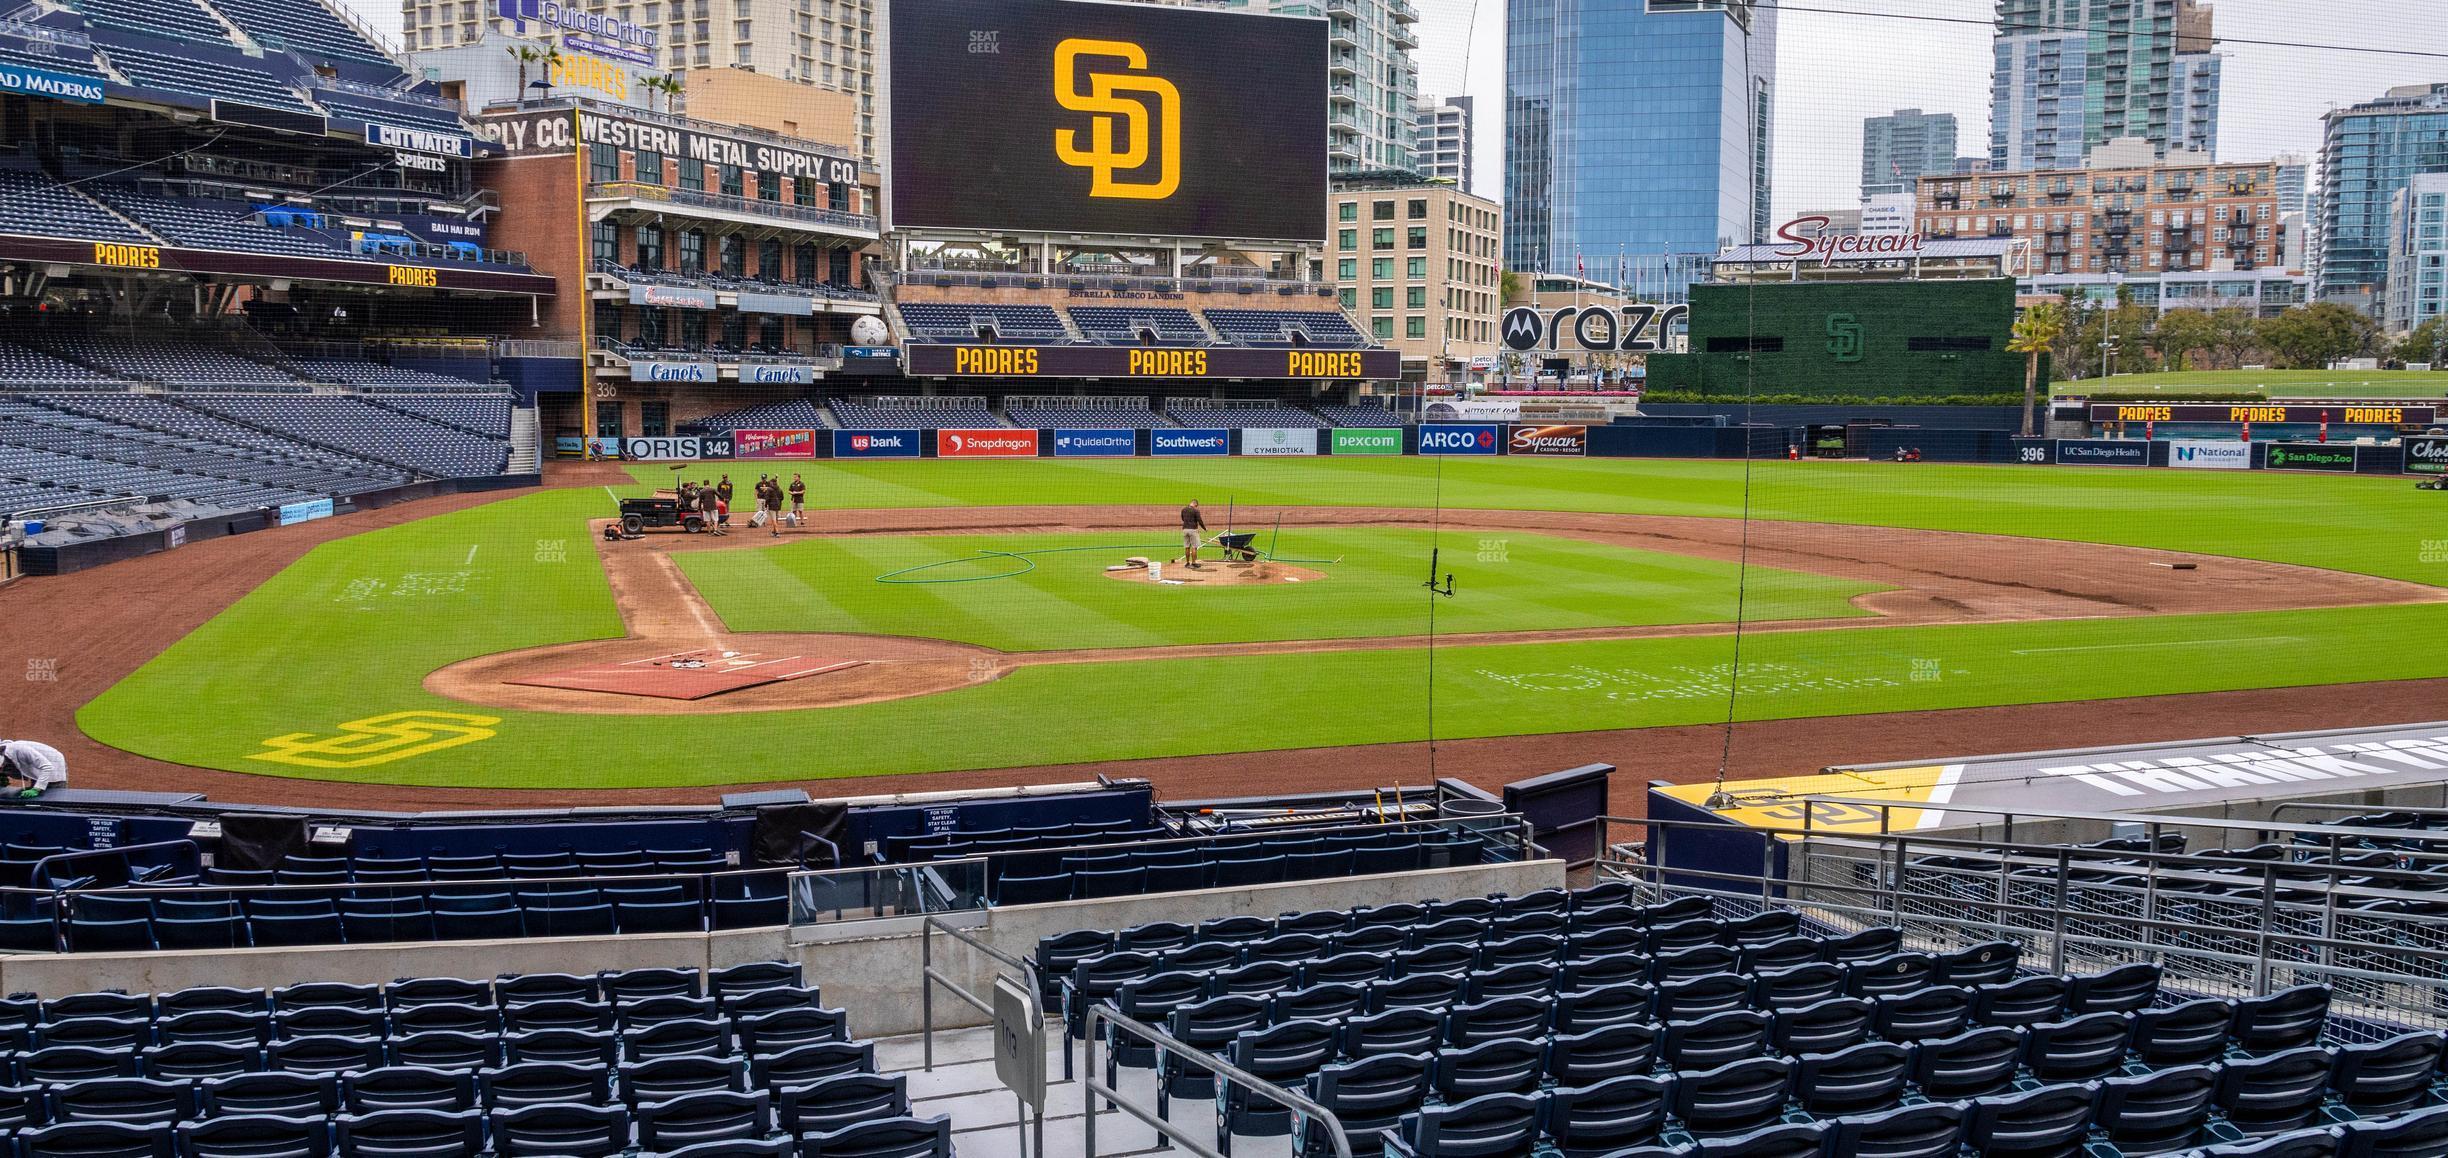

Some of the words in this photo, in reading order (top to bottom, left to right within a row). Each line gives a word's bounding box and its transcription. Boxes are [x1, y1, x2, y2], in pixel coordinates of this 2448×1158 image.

[542, 2, 657, 47] QuidelOrtho
[25, 74, 102, 100] MADERAS
[552, 54, 625, 101] PADRES
[379, 126, 462, 156] CUTWATER
[536, 117, 576, 149] CO.
[579, 114, 680, 156] WESTERN
[689, 134, 752, 168] METAL
[757, 147, 825, 180] SUPPLY
[830, 160, 858, 186] CO.
[395, 152, 446, 173] SPIRITS
[431, 222, 449, 233] BALI
[450, 224, 463, 235] HAI
[464, 225, 480, 237] RUM
[1774, 214, 1925, 267] Sycuan
[95, 243, 159, 268] PADRES
[389, 265, 437, 287] PADRES
[1068, 290, 1111, 299] ESTRELLA
[1112, 291, 1145, 299] JALISCO
[1147, 292, 1184, 301] LANDING
[1549, 304, 1689, 351] razr
[956, 347, 1039, 375] PADRES
[1129, 349, 1207, 376] PADRES
[1288, 351, 1362, 377] PADRES
[649, 363, 703, 381] Canel's
[755, 366, 801, 383] Canel's
[596, 382, 617, 397] 336
[2345, 408, 2402, 423] PADRES
[631, 439, 698, 458] ORIS
[706, 441, 730, 456] 342
[853, 437, 868, 447] us
[870, 436, 902, 448] bank
[967, 437, 1031, 450] Snapdragon
[1073, 437, 1131, 448] QuidelOrtho
[1156, 436, 1216, 448] Southwest
[1421, 431, 1475, 448] ARCO
[1512, 427, 1579, 453] Sycuan
[2020, 447, 2045, 462] 396
[2065, 447, 2078, 456] UC
[2078, 447, 2093, 456] San
[2093, 448, 2115, 458] Diego
[2115, 448, 2140, 457] Health
[2198, 447, 2245, 457] National
[2288, 453, 2305, 461] San
[2307, 454, 2333, 464] Diego
[2335, 455, 2352, 463] Zoo
[2036, 746, 2399, 797] THANK
[1001, 1018, 1017, 1060] 103
